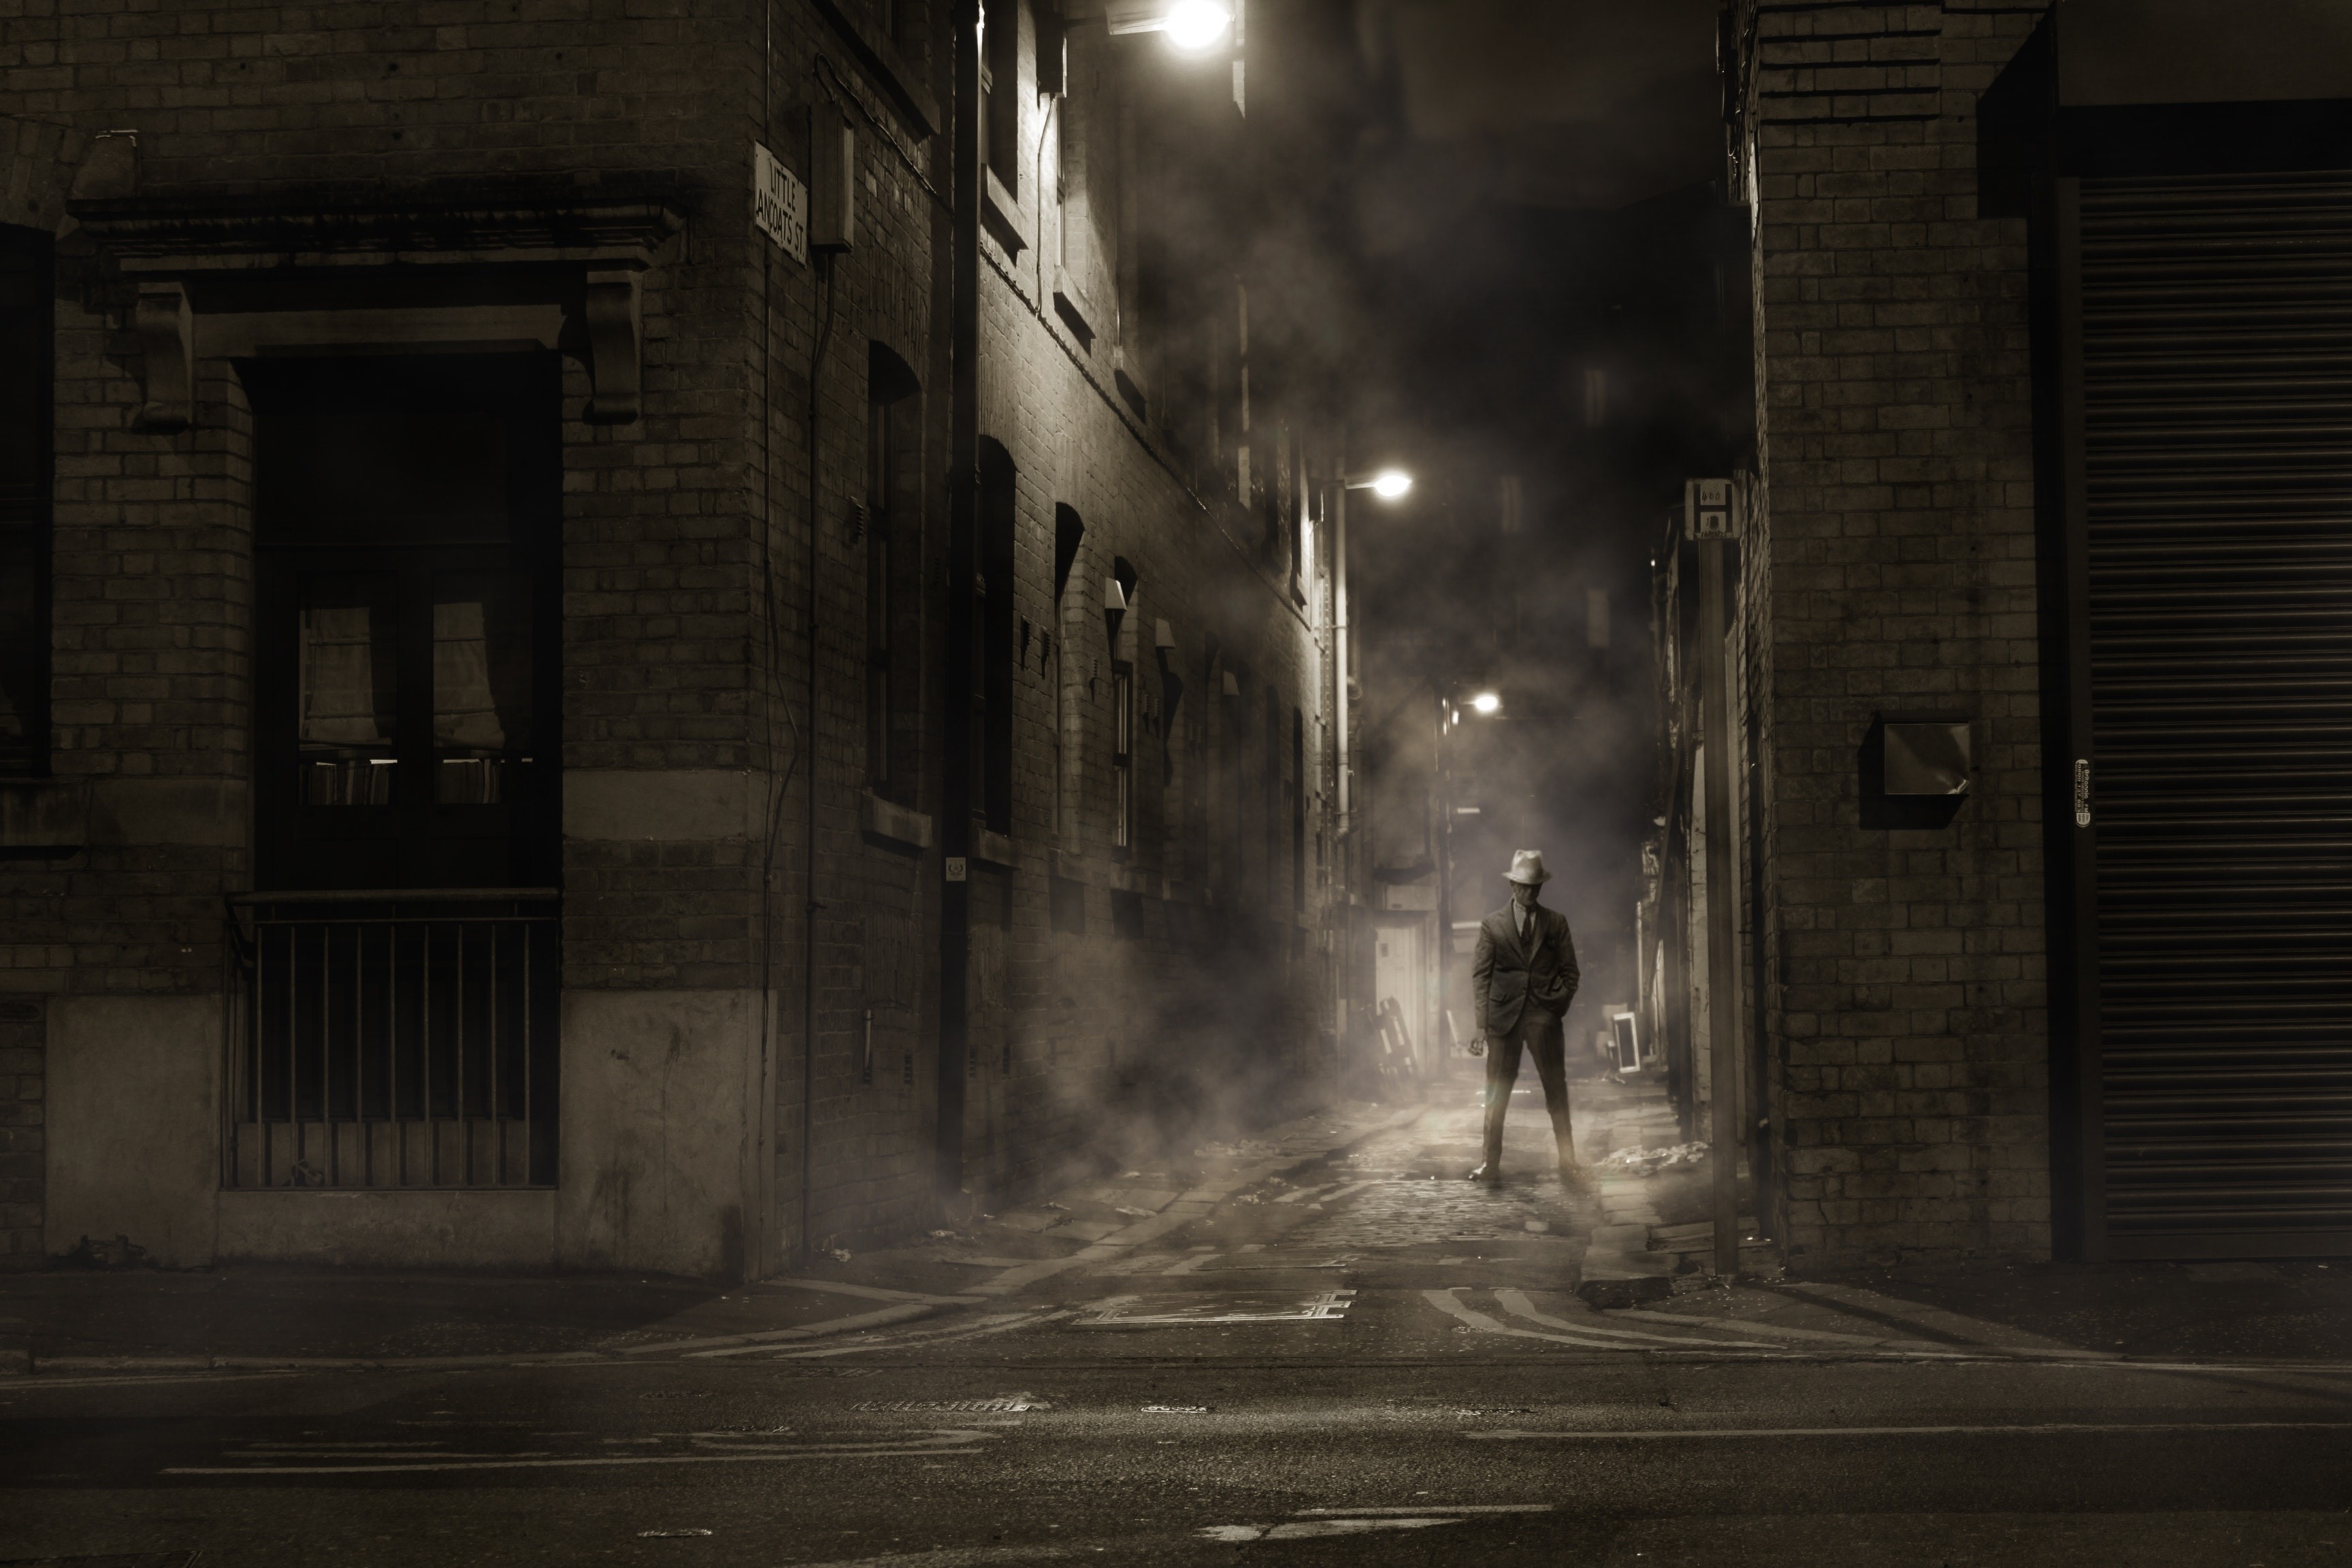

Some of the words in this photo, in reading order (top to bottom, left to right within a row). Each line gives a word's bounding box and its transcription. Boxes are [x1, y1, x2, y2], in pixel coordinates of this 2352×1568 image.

[770, 162, 796, 212] LITTLE
[757, 189, 792, 245] ANCOATS
[795, 222, 805, 257] ST.
[1702, 491, 1720, 502] 400
[2084, 804, 2089, 813] FM
